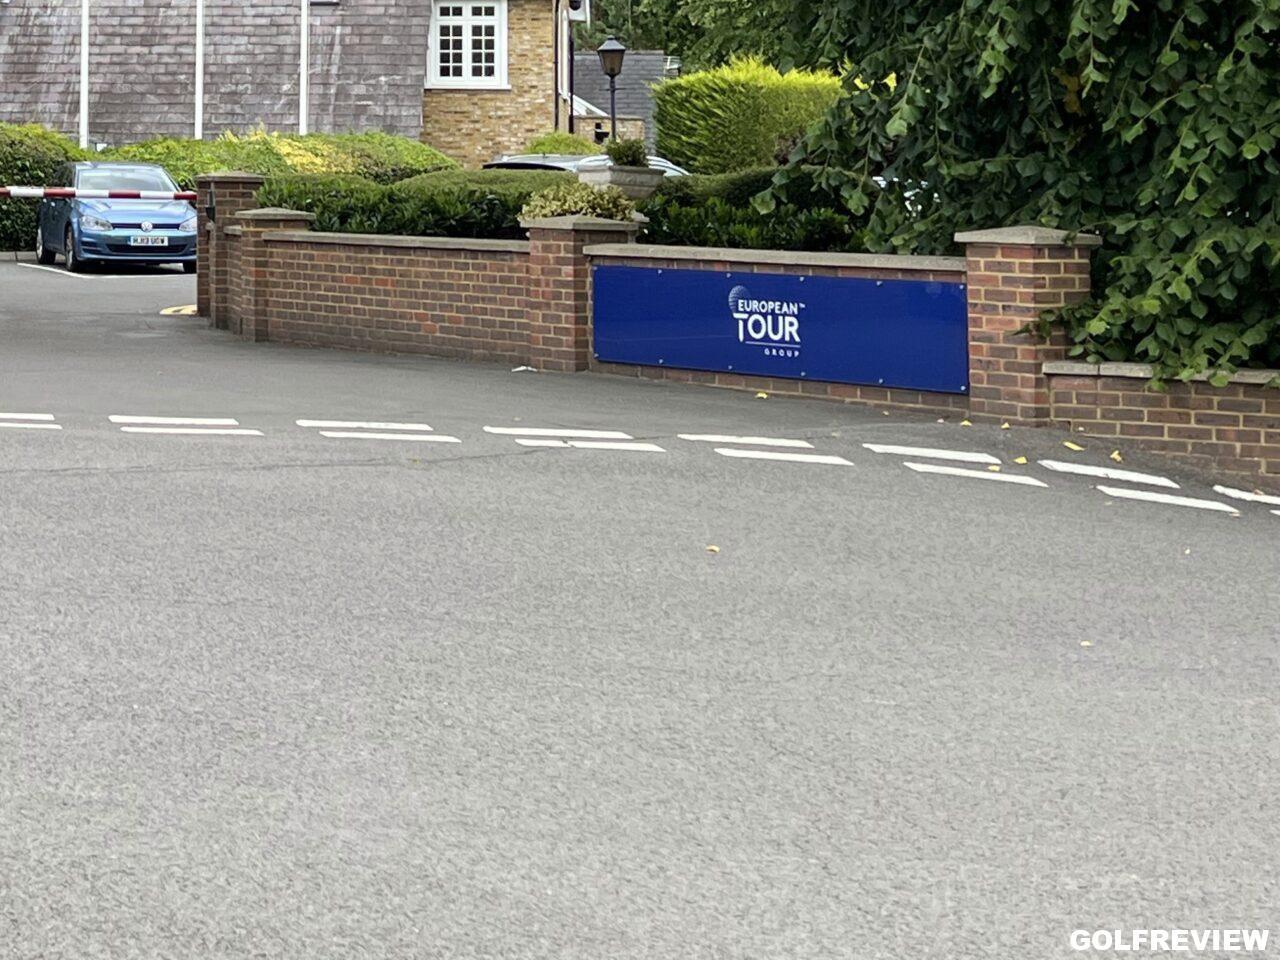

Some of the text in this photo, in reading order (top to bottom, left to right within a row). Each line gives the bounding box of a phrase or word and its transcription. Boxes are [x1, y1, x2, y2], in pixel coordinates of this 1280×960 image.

[737, 299, 799, 315] EUROPEAN
[732, 312, 801, 342] TOUR
[764, 347, 800, 358] GROUP
